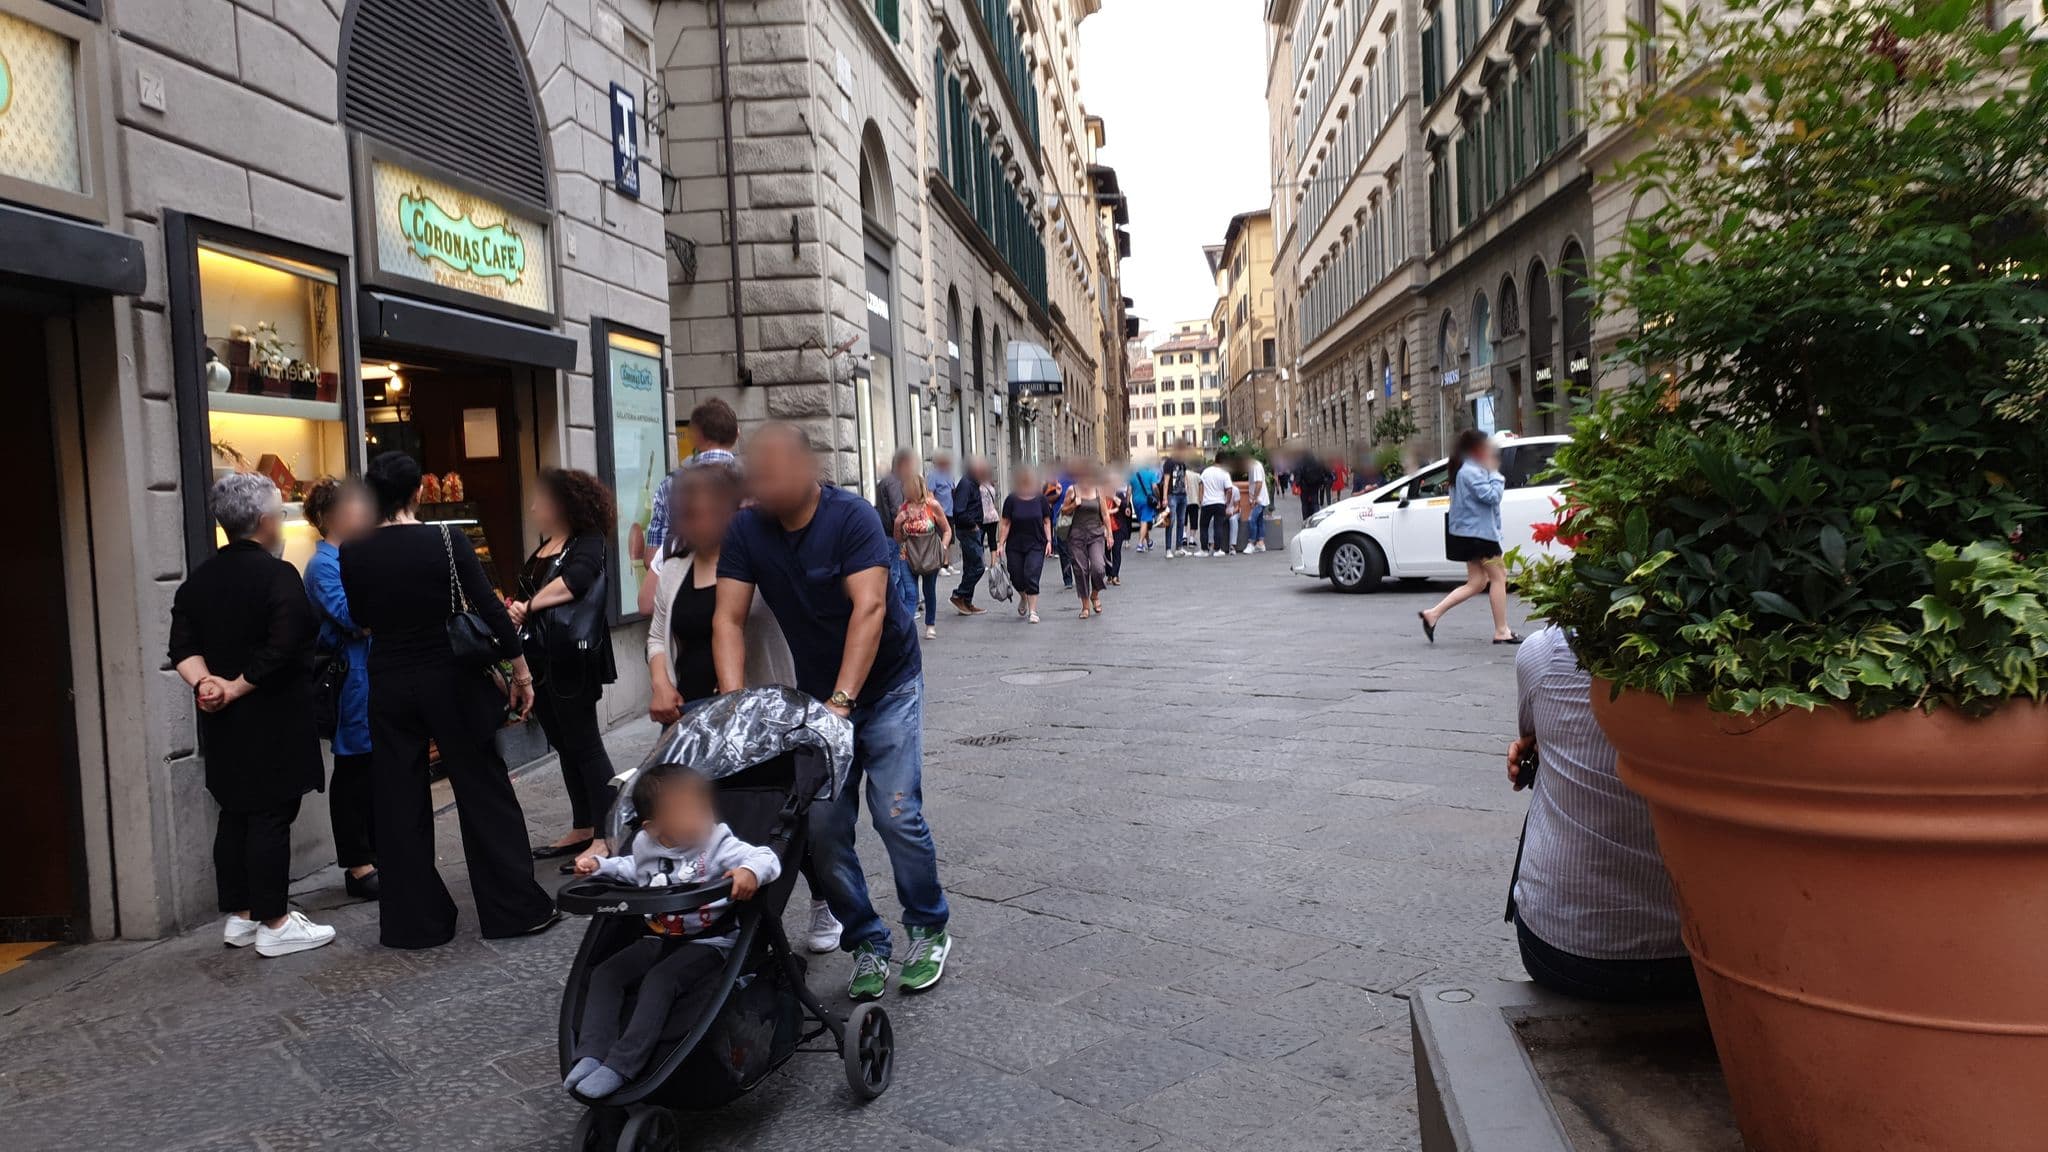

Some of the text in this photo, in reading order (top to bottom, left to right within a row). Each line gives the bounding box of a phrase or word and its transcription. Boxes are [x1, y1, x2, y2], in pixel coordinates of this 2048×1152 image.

[412, 208, 481, 265] CORONAS
[435, 269, 504, 298] PASTICCERIA
[1569, 357, 1589, 374] CHANEL
[1536, 367, 1552, 382] CHANEL
[596, 905, 618, 915] Safety
